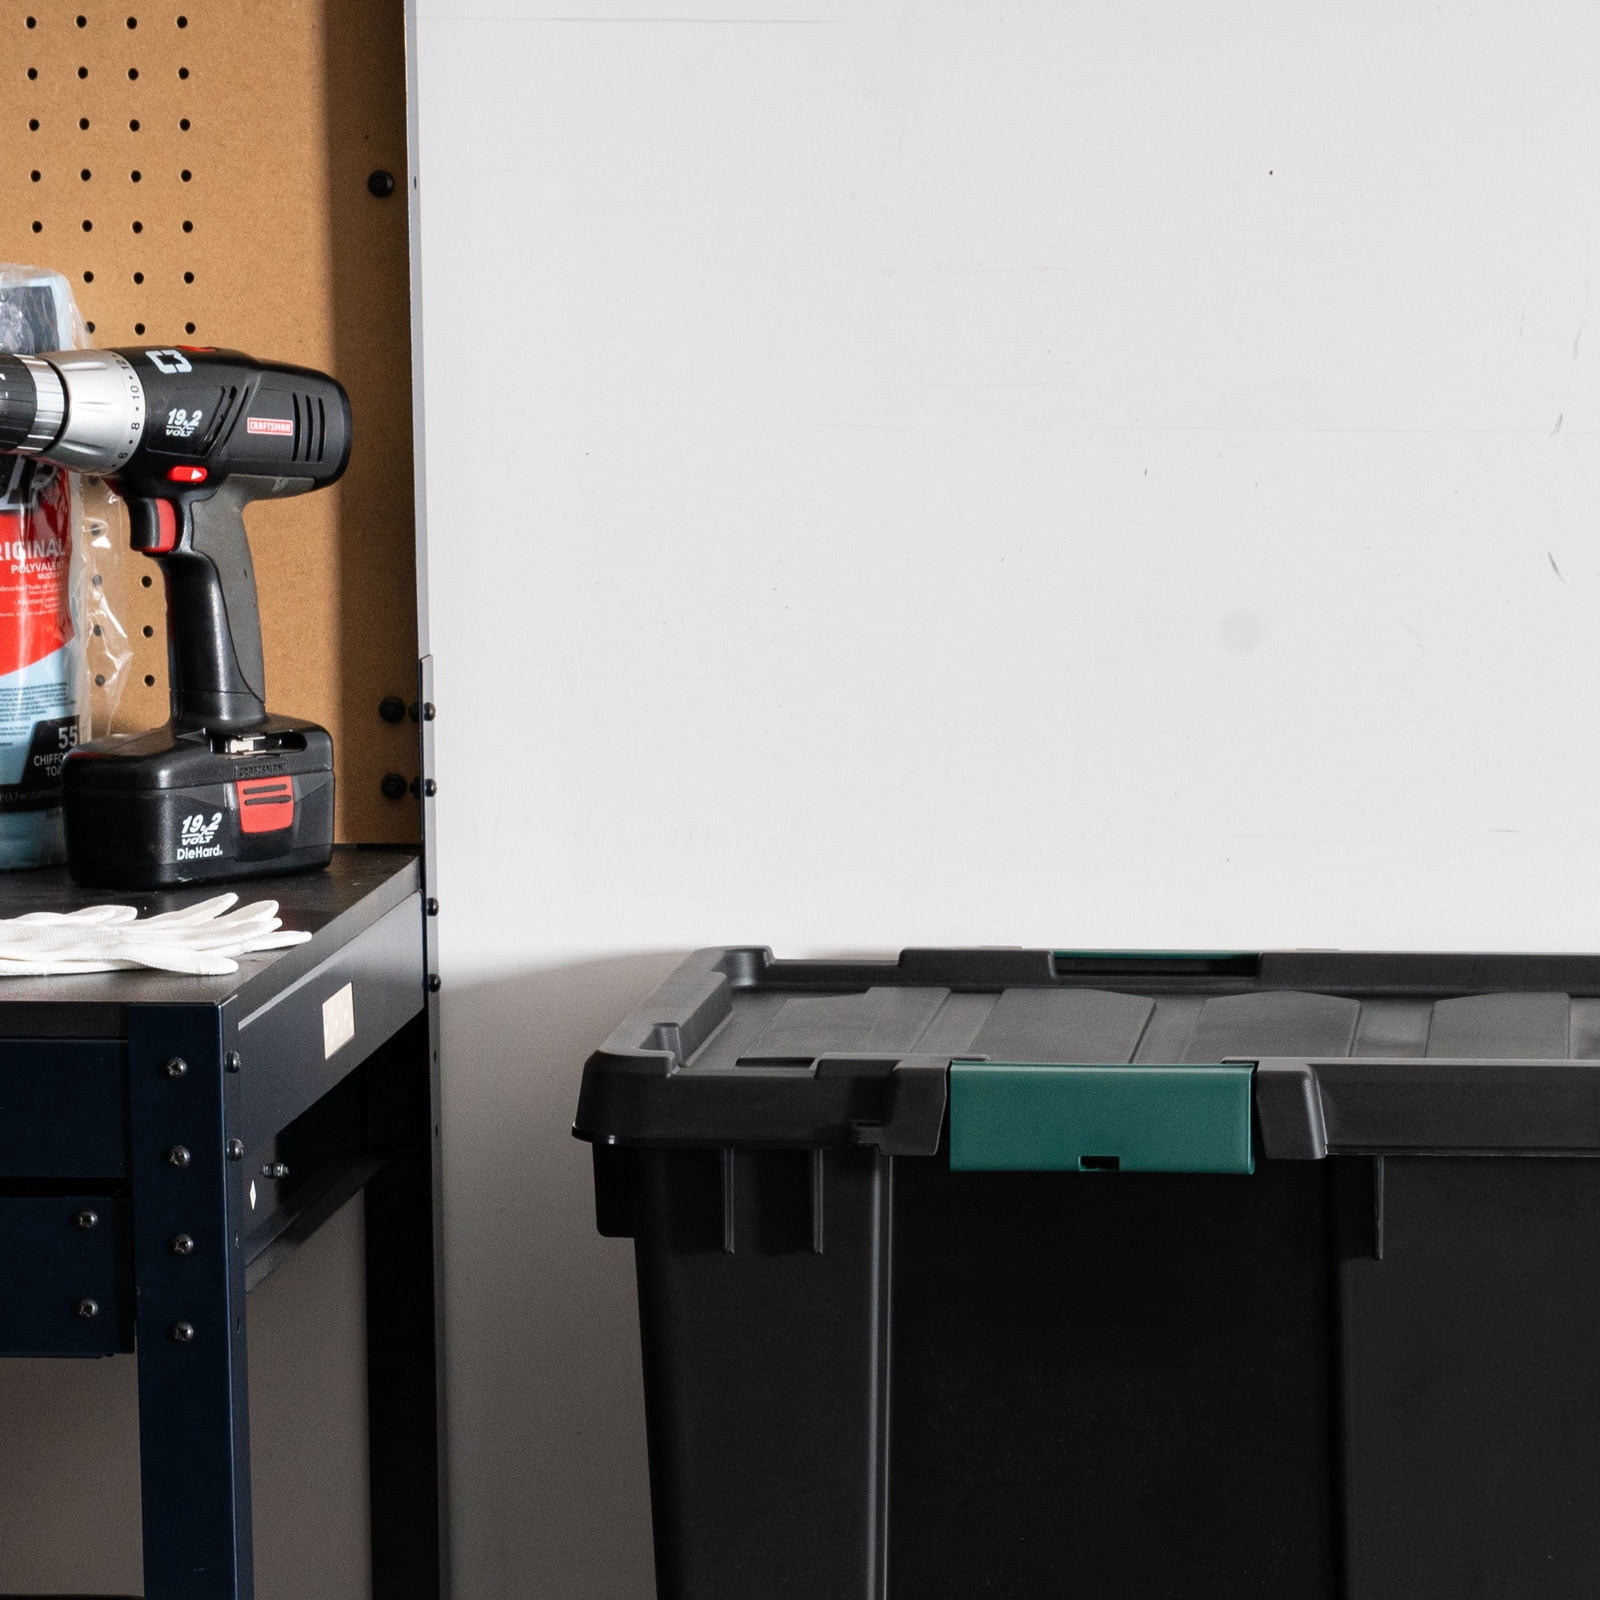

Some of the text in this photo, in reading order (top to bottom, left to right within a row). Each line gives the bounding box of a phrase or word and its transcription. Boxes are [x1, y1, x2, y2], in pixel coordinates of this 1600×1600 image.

[130, 385, 140, 400] 10
[131, 422, 140, 430] 8
[165, 428, 193, 437] VOLT
[249, 421, 291, 433] CRAFTSMAN
[58, 725, 78, 749] 55
[33, 752, 67, 767] CHIFFO
[181, 812, 222, 835] 19.2
[181, 835, 214, 846] VOLT
